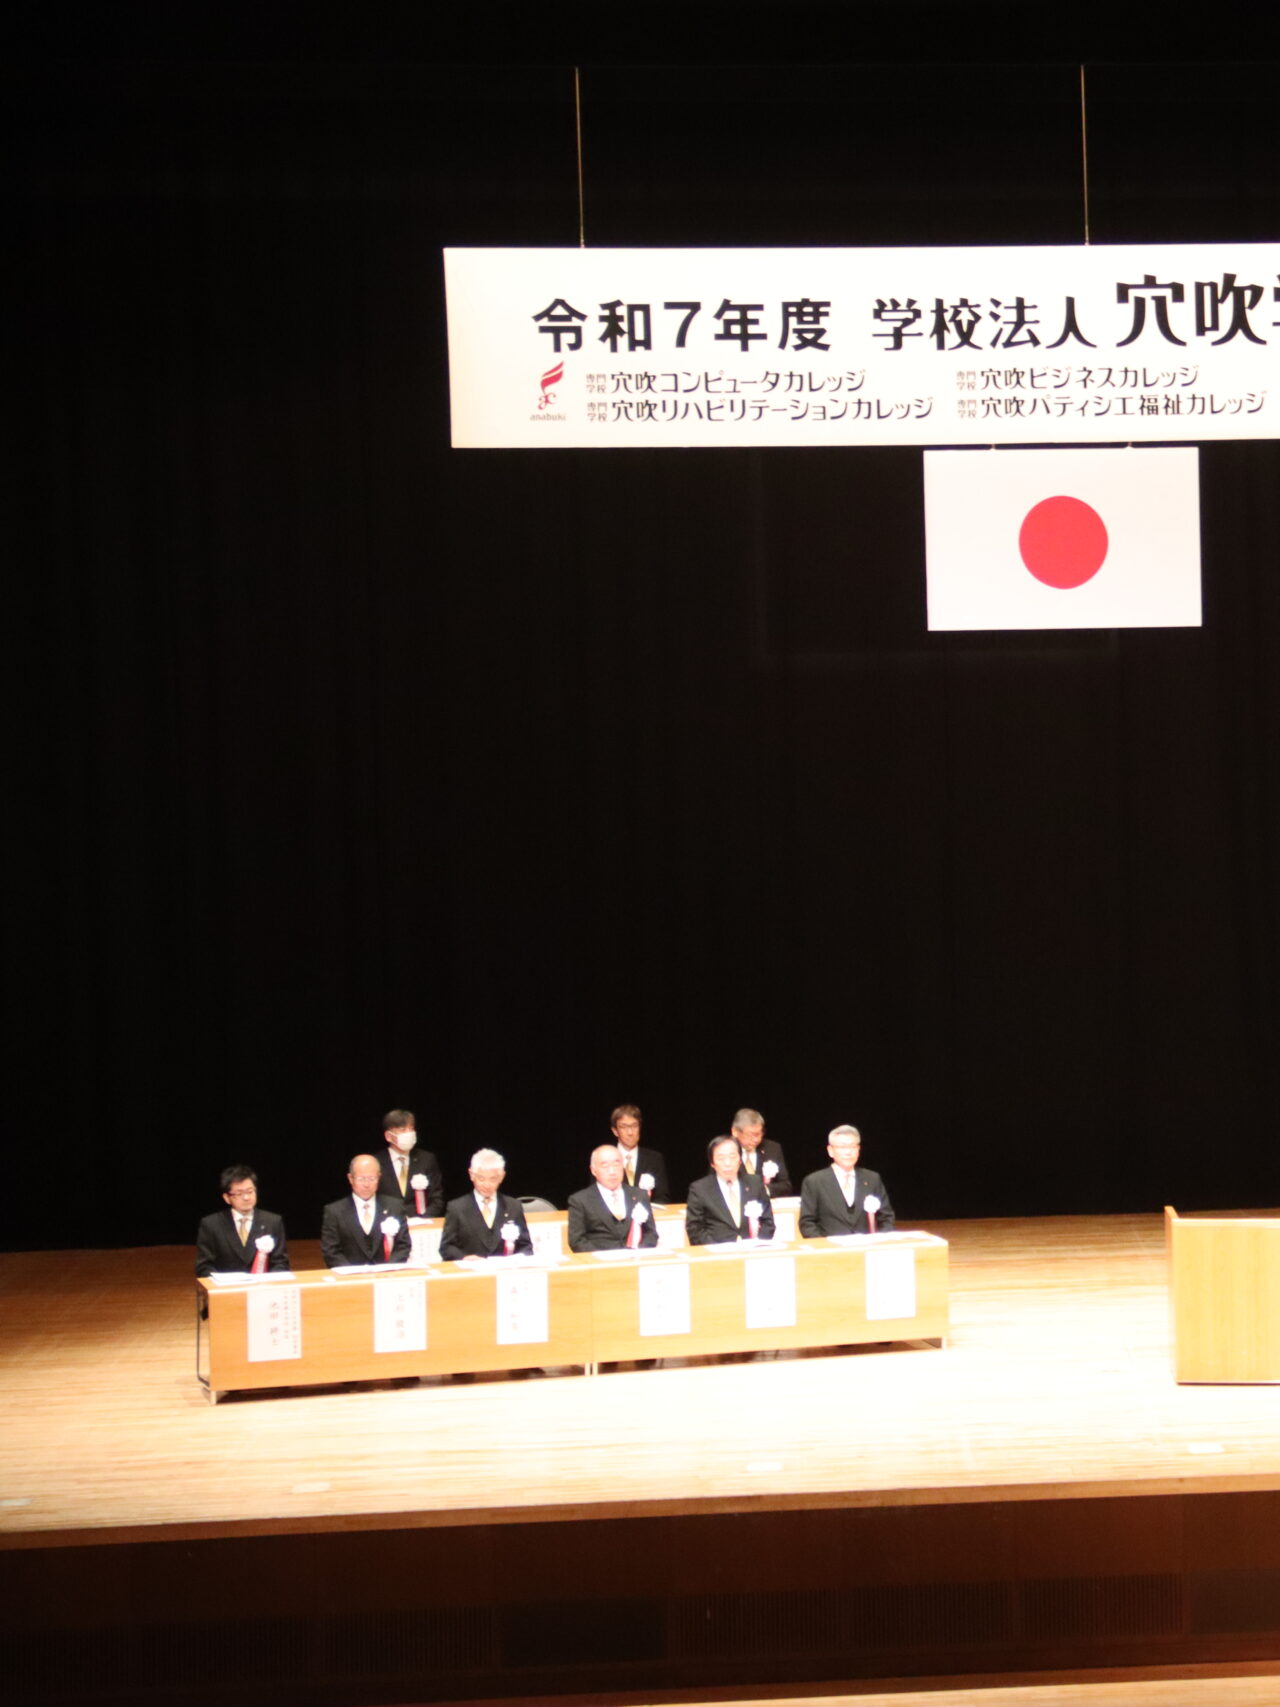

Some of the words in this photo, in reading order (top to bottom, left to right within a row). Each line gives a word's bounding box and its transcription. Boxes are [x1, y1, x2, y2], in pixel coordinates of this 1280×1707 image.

[532, 298, 831, 353] 令和7年度
[872, 296, 1097, 351] 学校法人
[611, 370, 865, 393] 穴吹コンピュータカレッジ
[981, 366, 1197, 389] 穴吹ビジネスカレッジ
[612, 397, 932, 422] 穴吹リハビリテーションカレッジ
[981, 392, 1265, 416] 穴吹パティシエ福祉カレッジ
